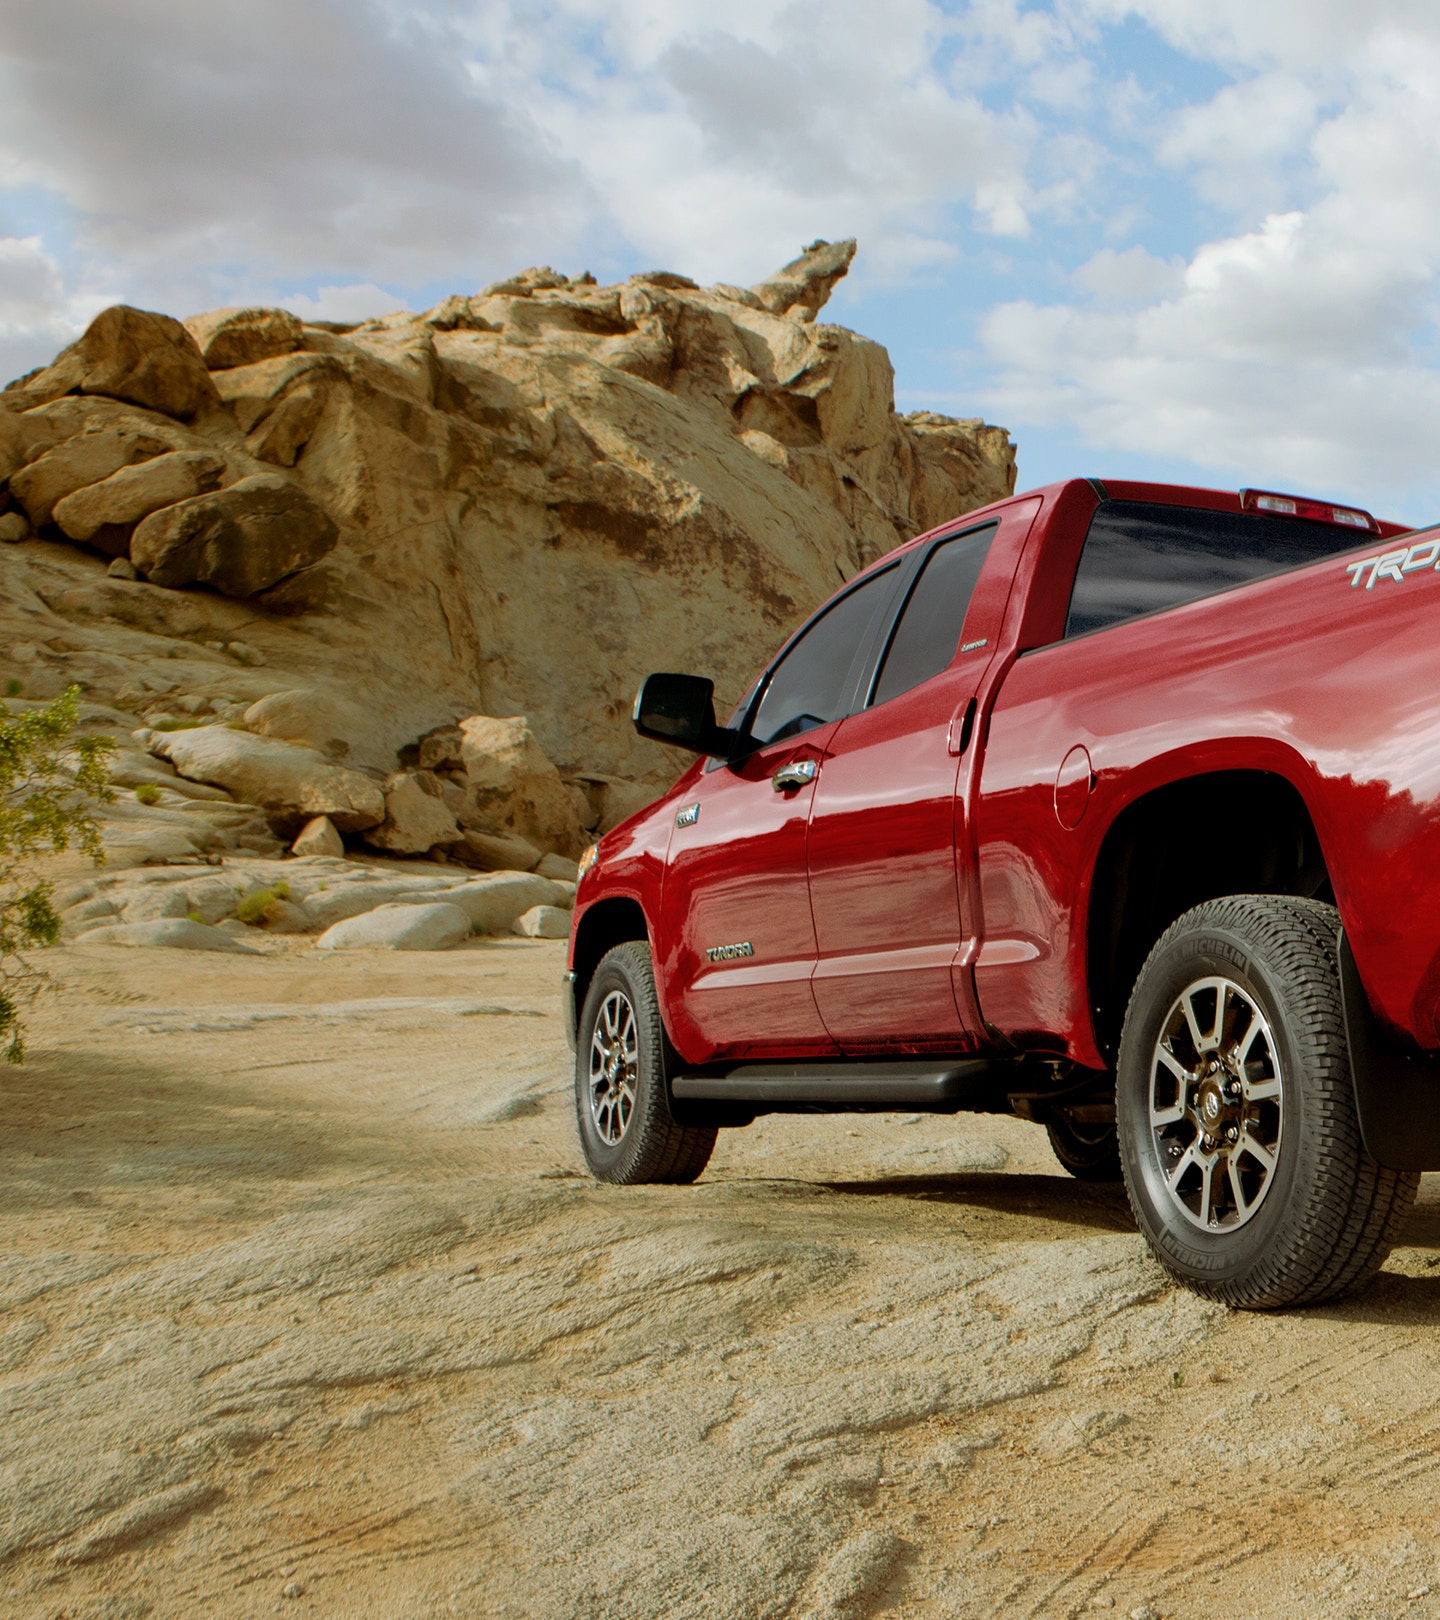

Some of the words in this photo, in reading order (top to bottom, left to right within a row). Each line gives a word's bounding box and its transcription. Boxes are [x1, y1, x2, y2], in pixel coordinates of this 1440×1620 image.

[706, 941, 753, 963] TUNDRA
[1182, 938, 1246, 970] MICHELIN
[1161, 1235, 1225, 1270] MICHELIN
